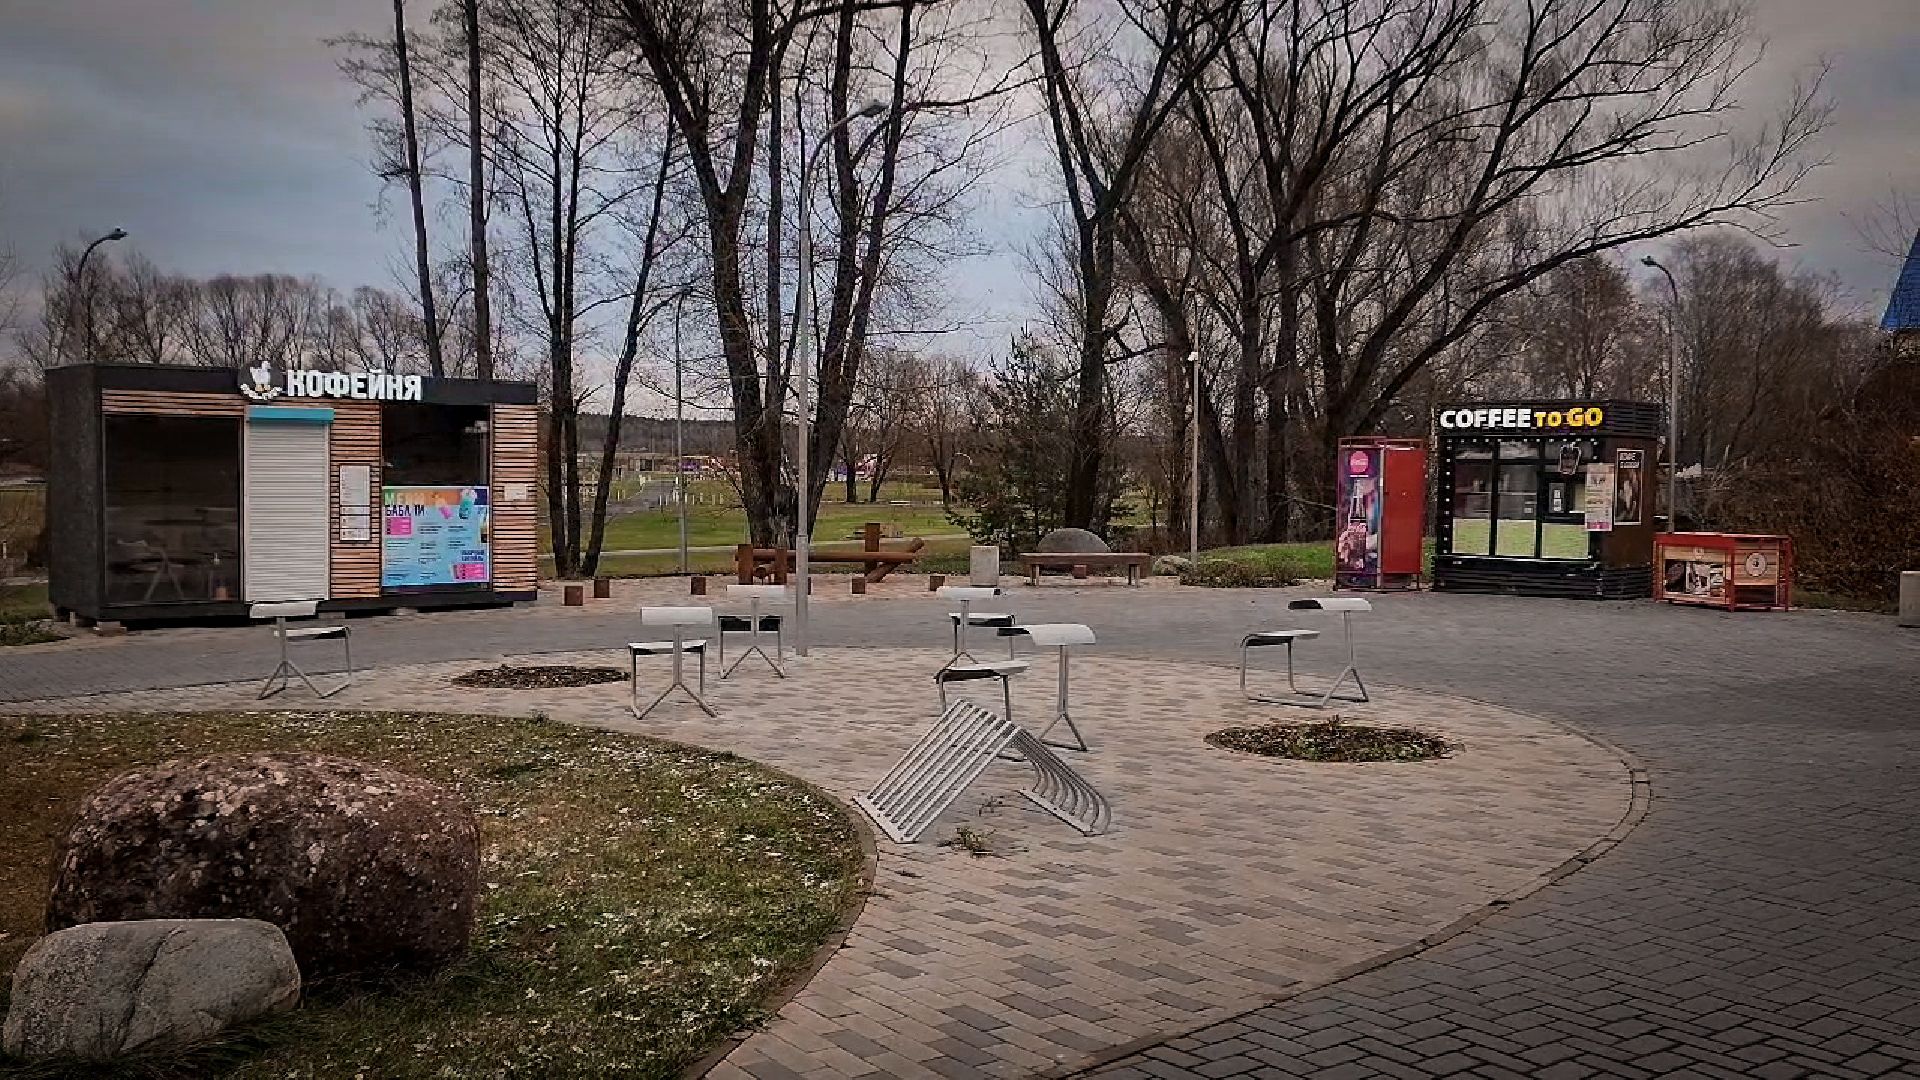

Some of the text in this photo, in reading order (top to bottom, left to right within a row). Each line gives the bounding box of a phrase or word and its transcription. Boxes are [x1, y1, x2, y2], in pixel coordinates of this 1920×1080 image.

[287, 369, 422, 400] КОФЕЙНЯ
[1440, 407, 1603, 428] COFFEE TO GO
